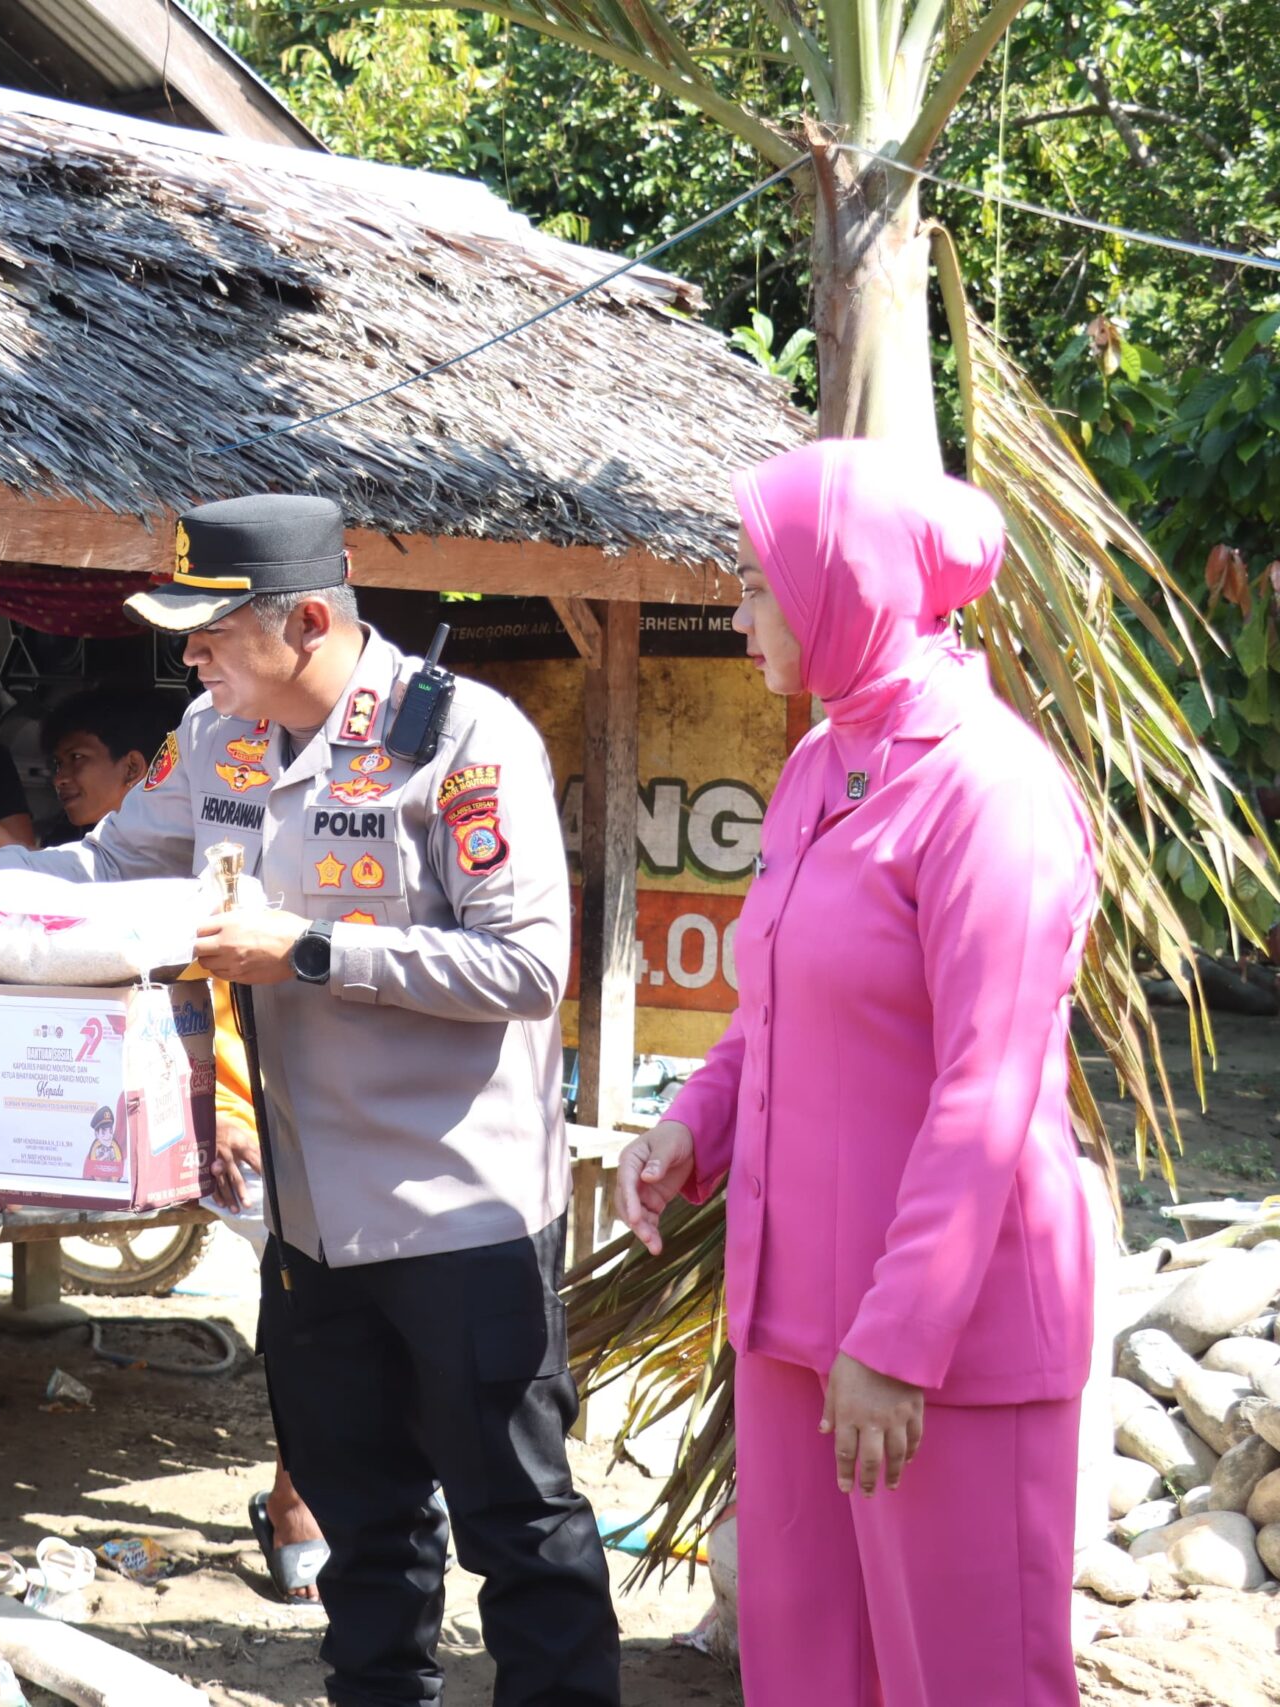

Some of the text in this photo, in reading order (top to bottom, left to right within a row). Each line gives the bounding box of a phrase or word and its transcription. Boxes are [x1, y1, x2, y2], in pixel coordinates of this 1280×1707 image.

[639, 617, 703, 630] ERHENTI
[708, 617, 734, 630] ME
[437, 766, 497, 799] POLRES
[201, 796, 266, 830] HENDRAWAN
[314, 811, 385, 838] POLRI
[36, 1080, 64, 1099] Kepada
